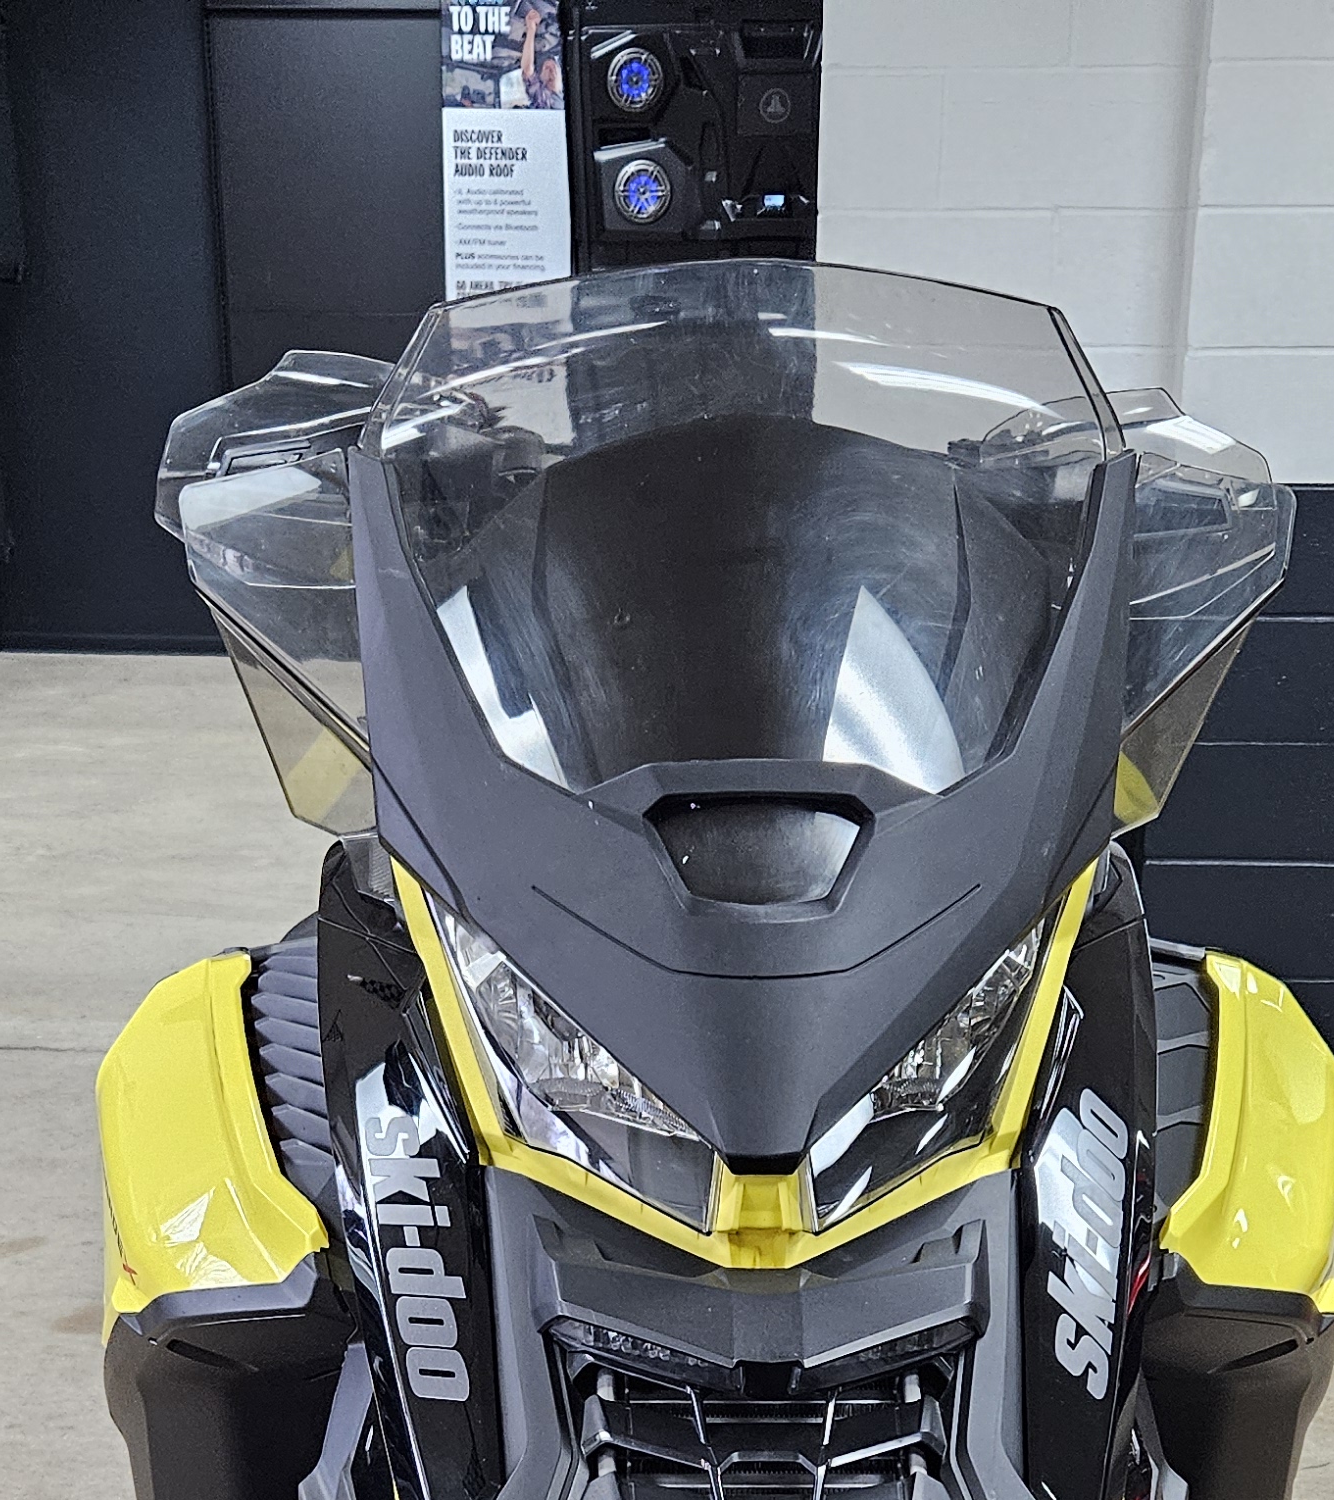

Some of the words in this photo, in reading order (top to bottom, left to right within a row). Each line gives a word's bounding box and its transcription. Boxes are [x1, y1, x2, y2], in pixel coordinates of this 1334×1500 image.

[449, 5, 474, 33] TO
[476, 5, 511, 34] THE
[450, 34, 495, 62] BEAT
[453, 129, 503, 144] DISCOVER
[453, 146, 472, 161] THE
[476, 146, 528, 161] DEFENDER
[453, 163, 485, 177] AUDIO
[489, 163, 515, 178] ROOF
